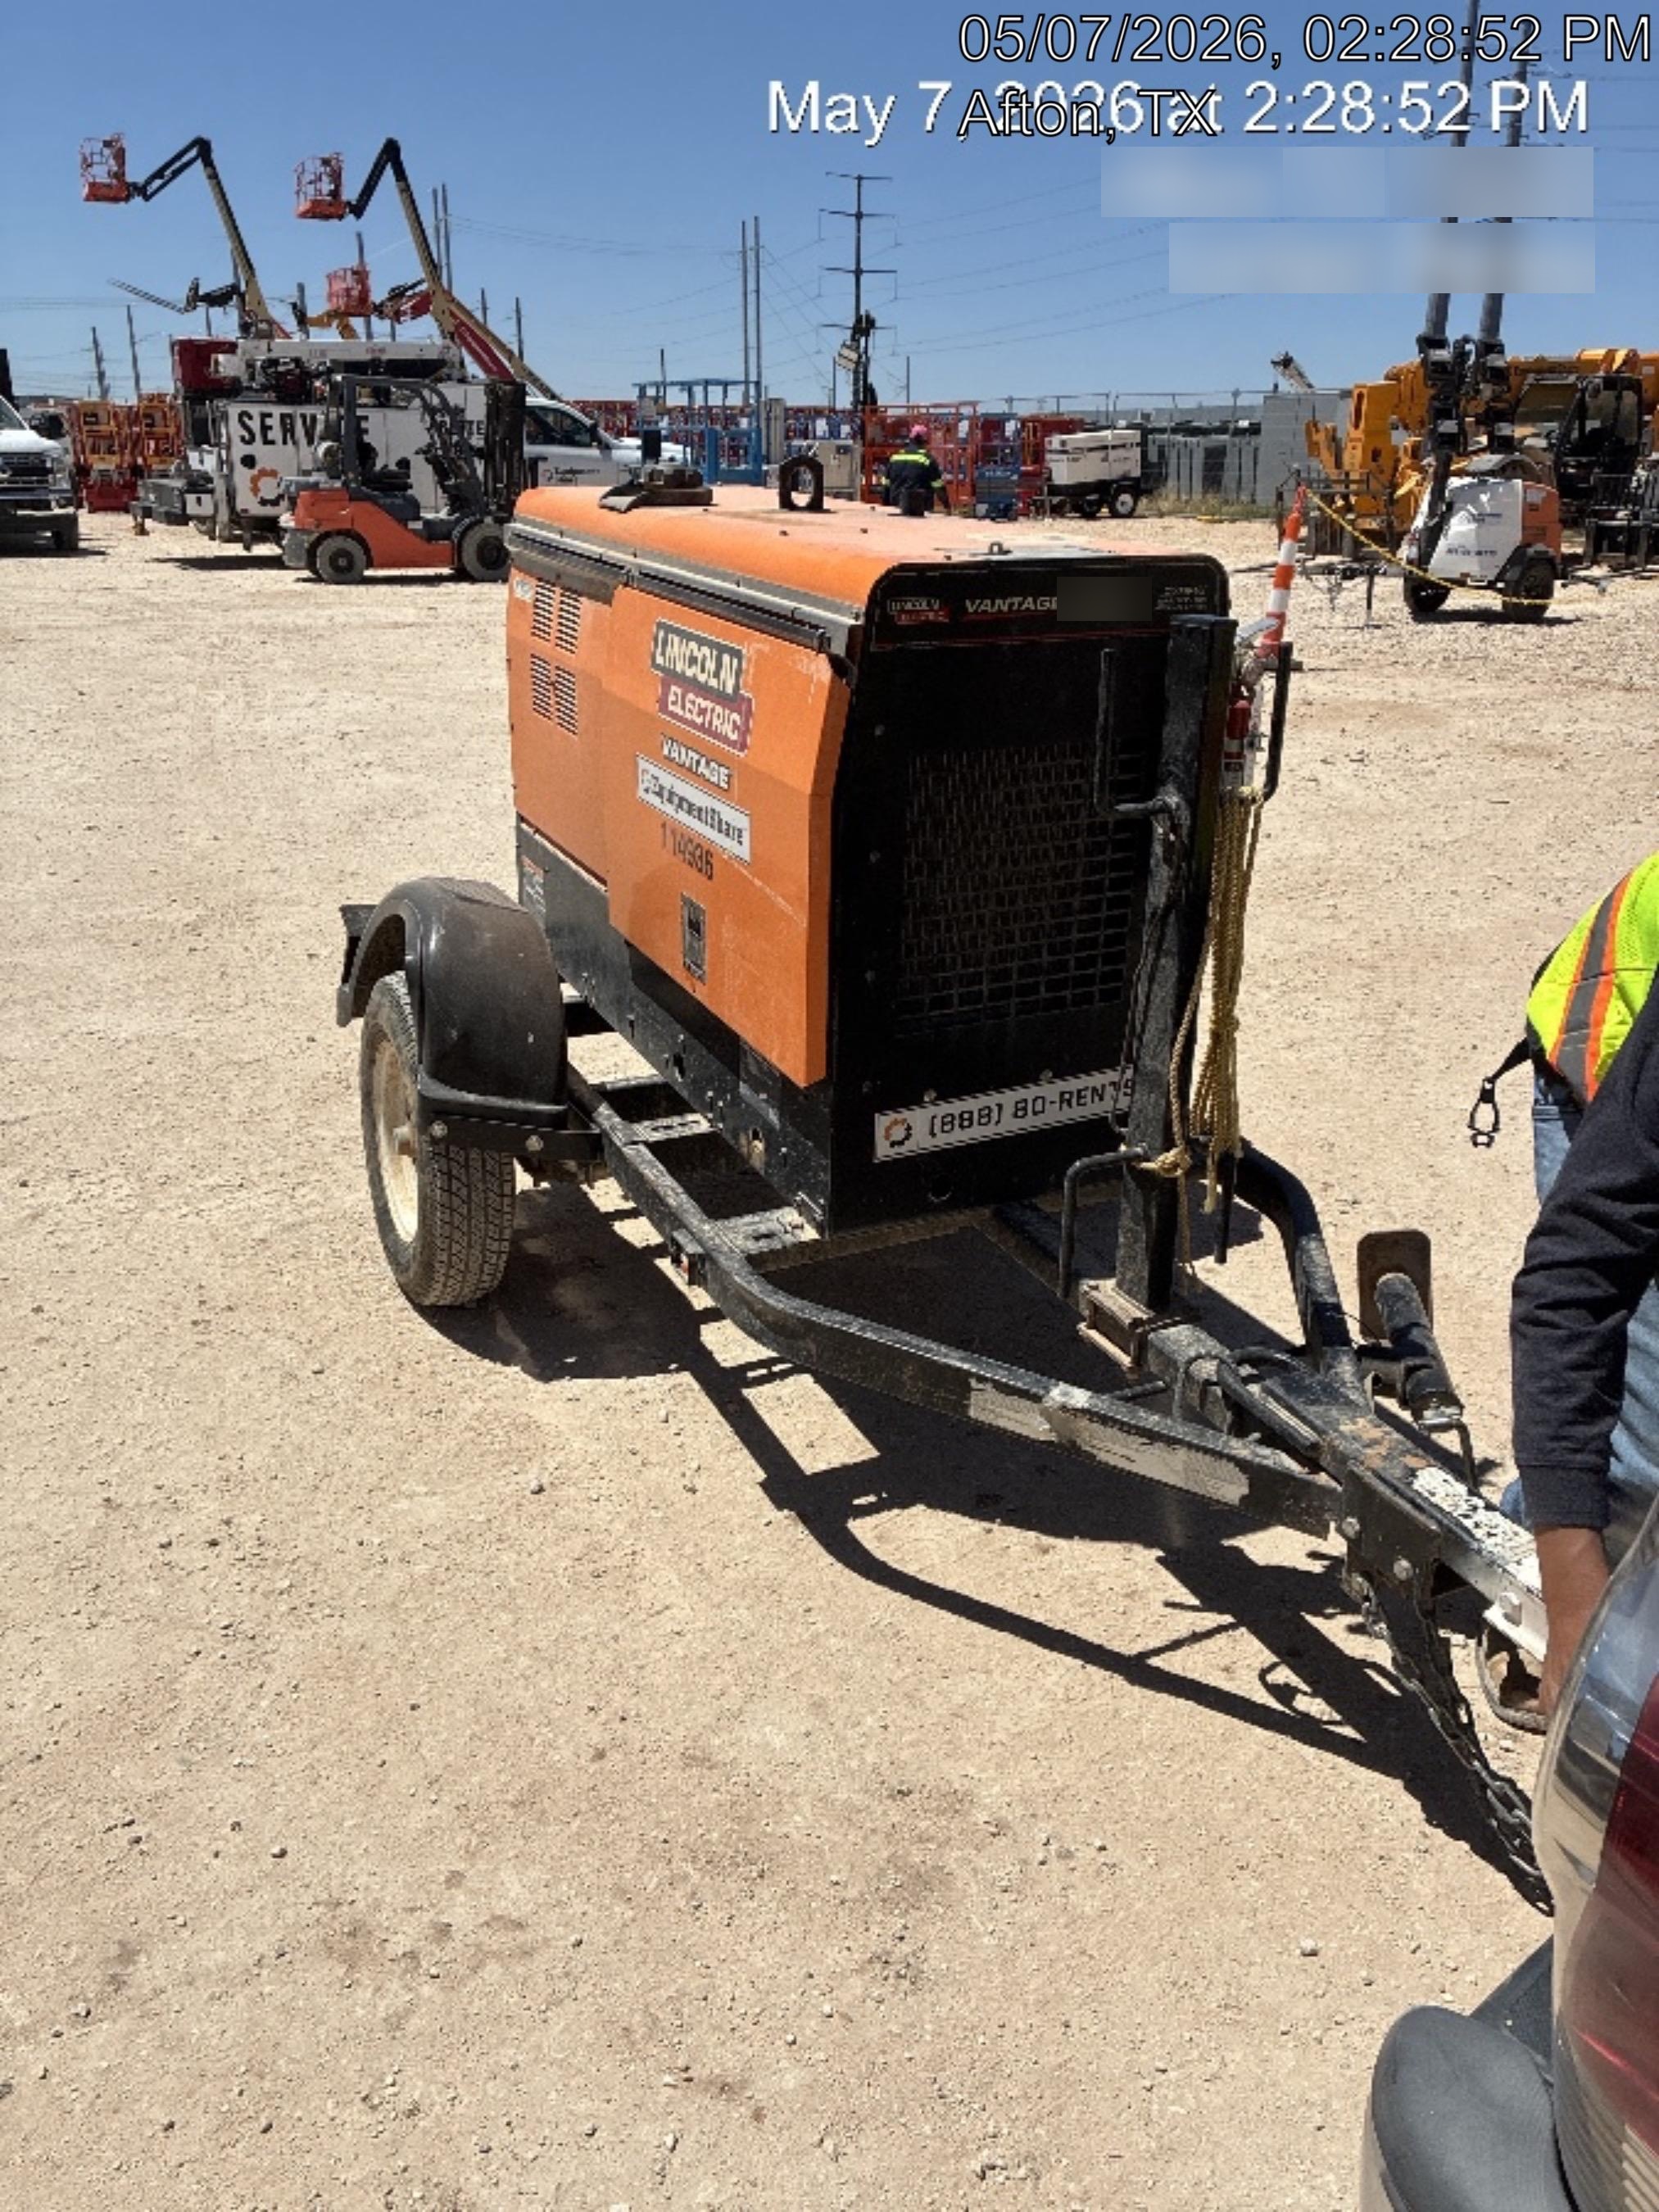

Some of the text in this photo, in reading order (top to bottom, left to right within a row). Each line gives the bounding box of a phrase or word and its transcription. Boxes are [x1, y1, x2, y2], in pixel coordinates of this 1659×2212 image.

[238, 410, 369, 447] SERVE
[655, 628, 738, 696] LINCOLN
[667, 684, 741, 738] ELECTRIC
[661, 736, 731, 791] VANTAGE
[650, 773, 744, 847] EquipmentShare
